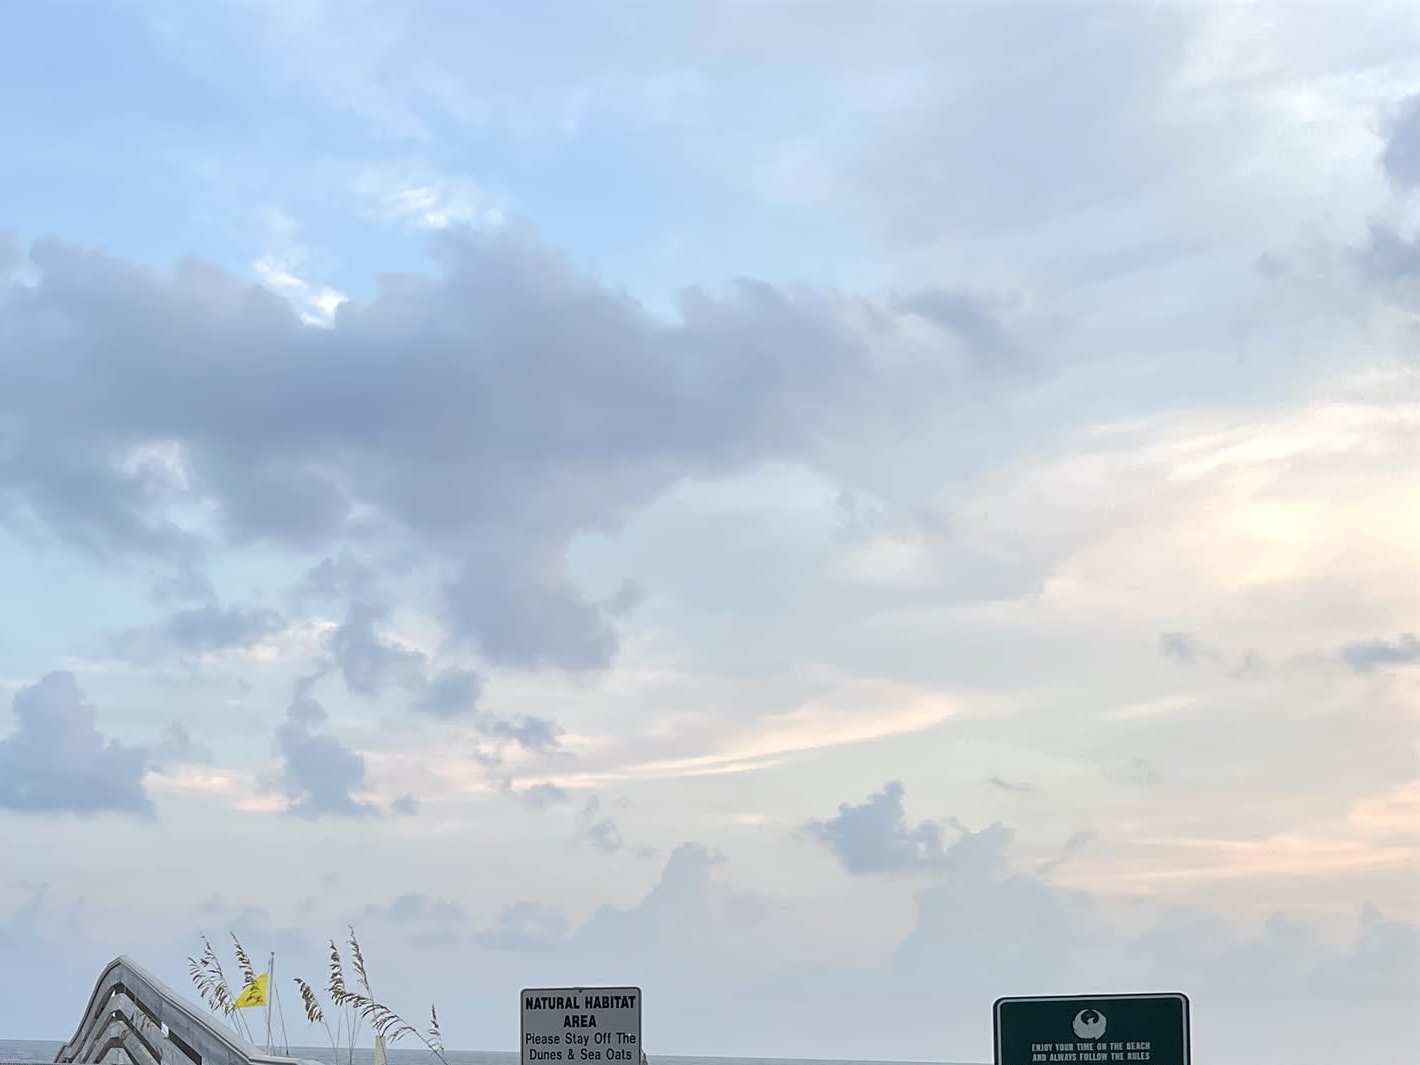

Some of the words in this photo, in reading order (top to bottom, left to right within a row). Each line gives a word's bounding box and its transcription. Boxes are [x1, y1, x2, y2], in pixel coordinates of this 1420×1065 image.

[525, 996, 580, 1010] NATURAL
[585, 995, 636, 1009] HABITAT
[563, 1014, 597, 1028] AREA
[525, 1032, 560, 1045] Please
[565, 1032, 589, 1047] Stay
[594, 1032, 612, 1045] Off
[616, 1032, 636, 1045] The
[1031, 1043, 1053, 1052] ENJOY
[1055, 1043, 1074, 1051] YOUR
[1077, 1042, 1094, 1051] TIME
[1096, 1042, 1107, 1050] ON
[1110, 1042, 1124, 1050] THE
[1126, 1041, 1151, 1050] BEACH
[529, 1048, 563, 1060] Dunes
[567, 1048, 575, 1060] &
[580, 1048, 601, 1060] Sea
[606, 1047, 632, 1060] Oats
[1032, 1053, 1047, 1062] AND
[1049, 1053, 1077, 1062] ALWAYS
[1079, 1052, 1108, 1061] FOLLOW
[1111, 1052, 1124, 1061] THE
[1127, 1051, 1150, 1061] RULES
